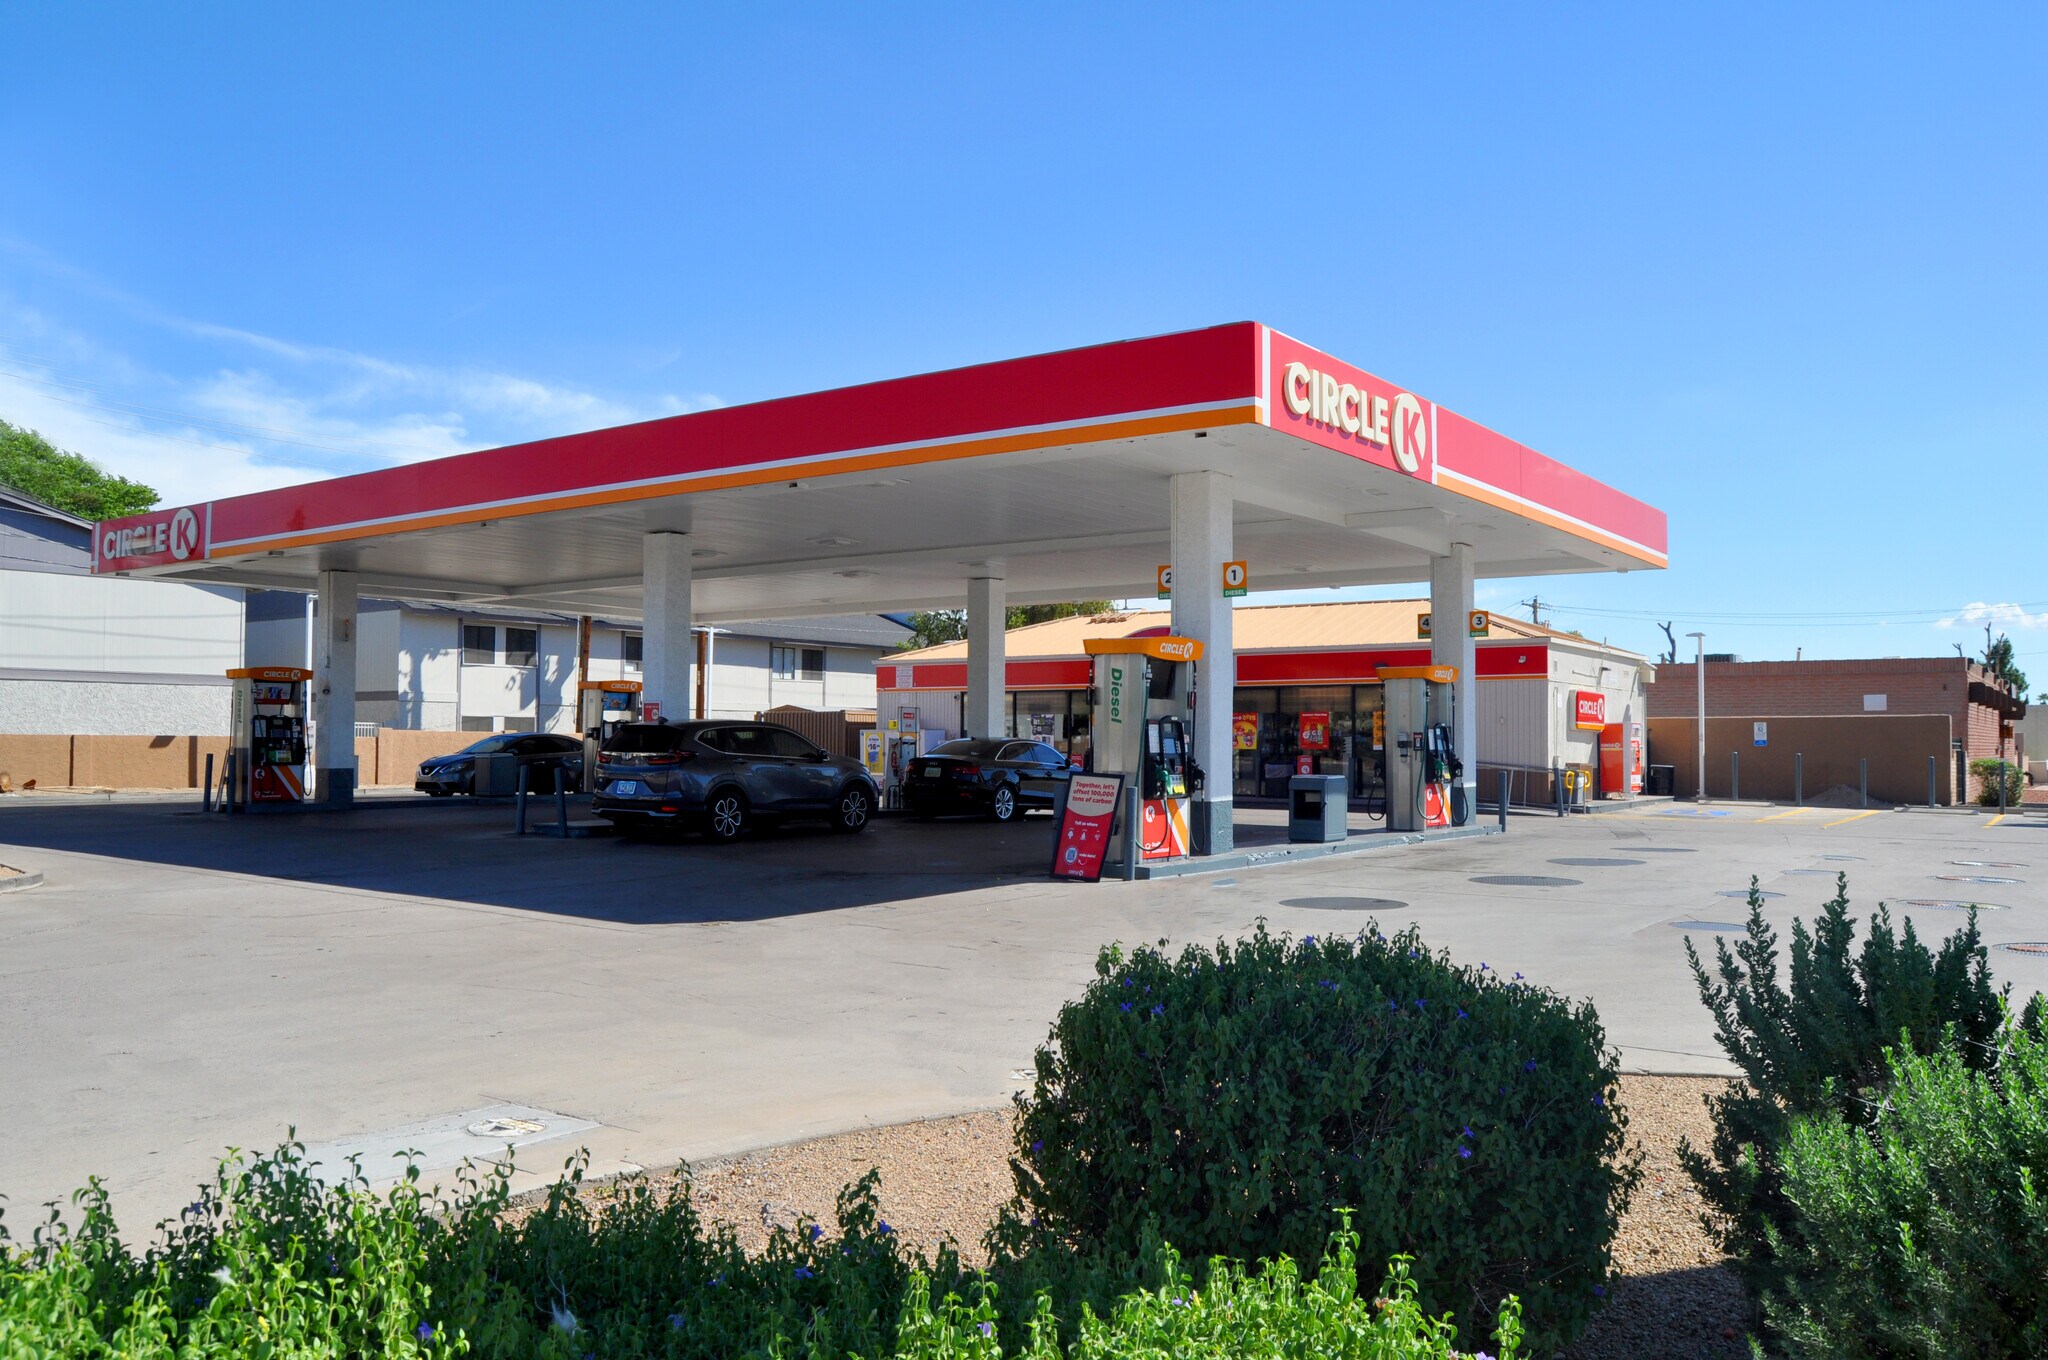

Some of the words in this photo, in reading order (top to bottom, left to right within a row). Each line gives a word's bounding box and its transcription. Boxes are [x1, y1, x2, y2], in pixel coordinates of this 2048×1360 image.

[1284, 361, 1389, 445] CIRCLE
[1396, 396, 1426, 471] K
[103, 522, 168, 560] CIRCLE
[172, 511, 197, 559] K
[1165, 572, 1172, 584] 2
[1231, 569, 1237, 581] 1
[1422, 618, 1430, 627] 4
[1475, 616, 1483, 626] 3
[1160, 643, 1184, 655] CIRCLE
[1184, 642, 1194, 658] K
[291, 670, 301, 680] K
[1111, 667, 1122, 724] Diesel
[1579, 700, 1597, 715] CIRCLE
[1597, 698, 1604, 720] K
[1076, 781, 1101, 789] Together,
[1091, 790, 1115, 798] 100,000
